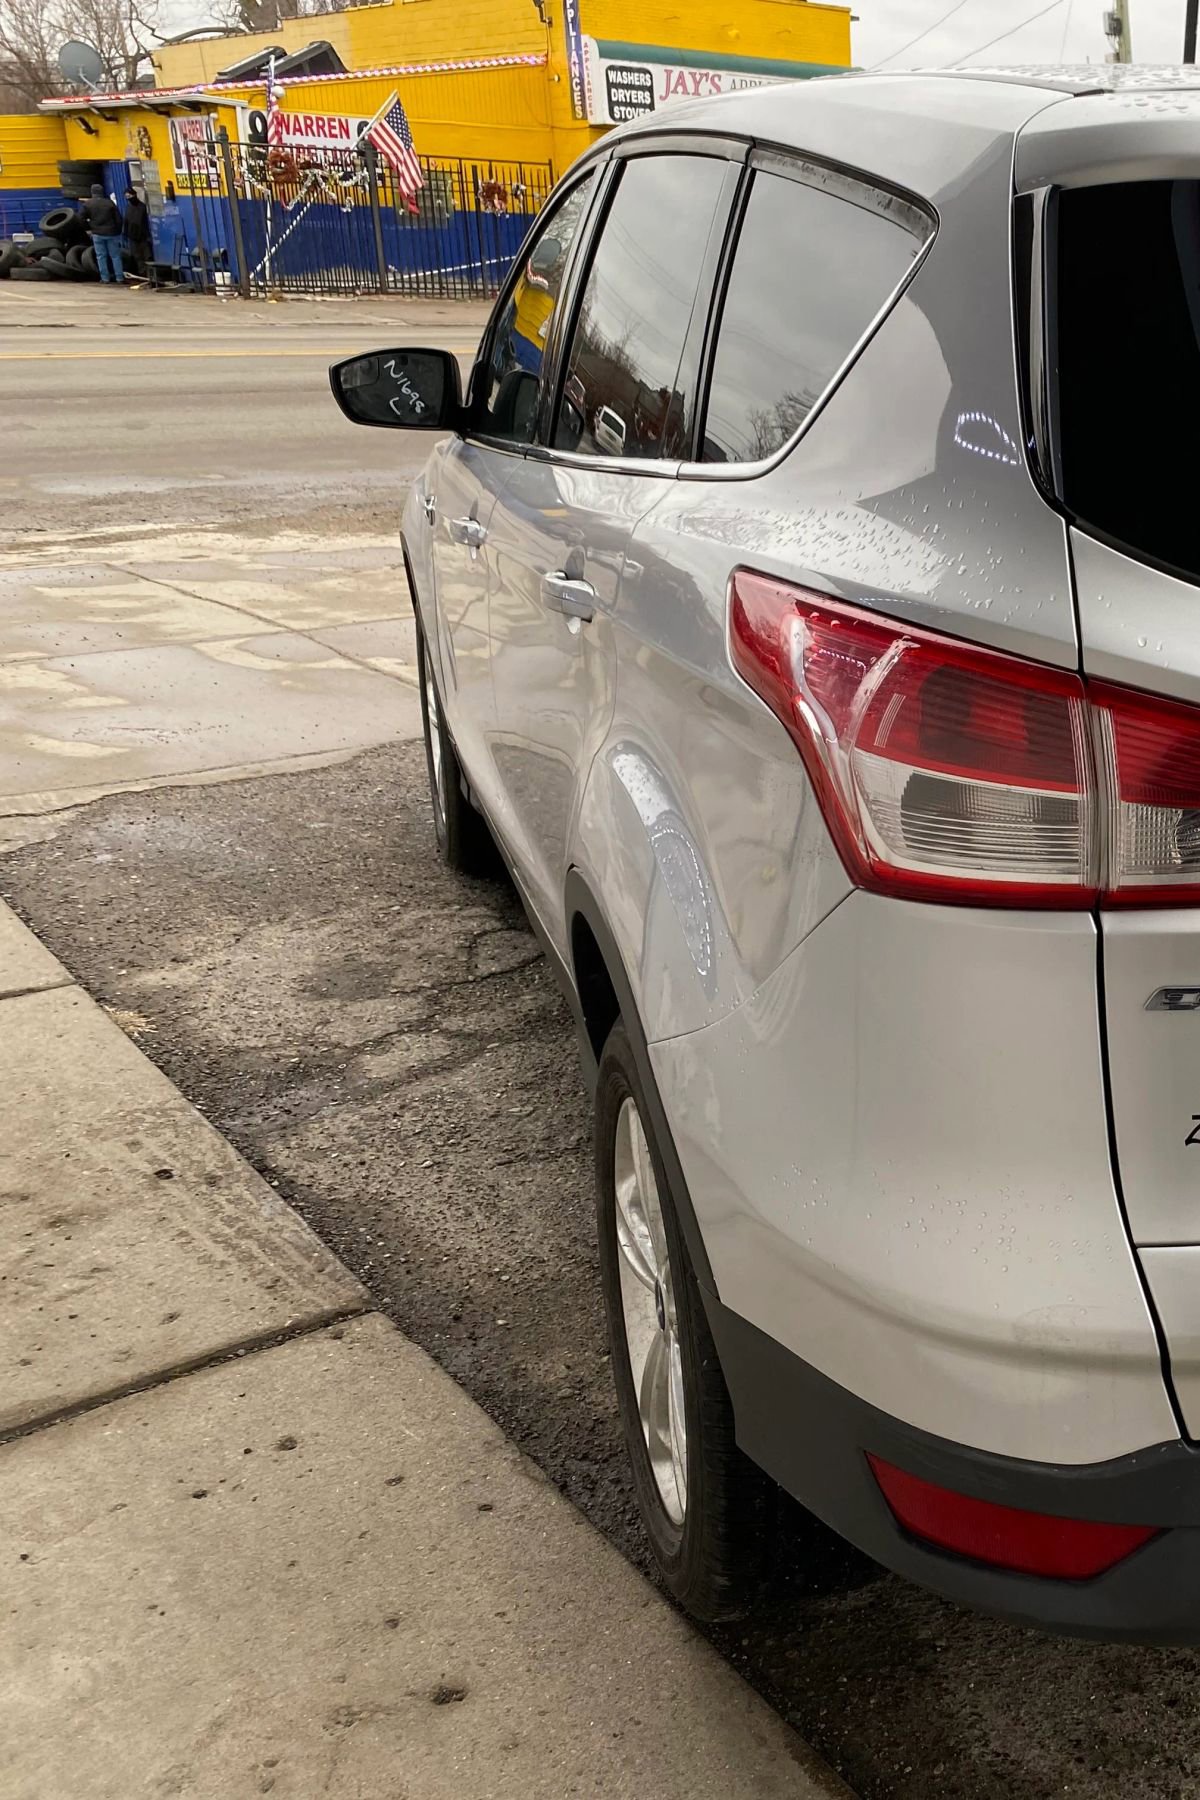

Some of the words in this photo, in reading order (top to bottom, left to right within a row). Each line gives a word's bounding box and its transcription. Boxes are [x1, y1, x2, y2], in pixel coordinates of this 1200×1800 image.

[607, 70, 652, 87] WASHERS
[659, 69, 722, 101] JAY'S
[611, 88, 652, 105] DRYERS
